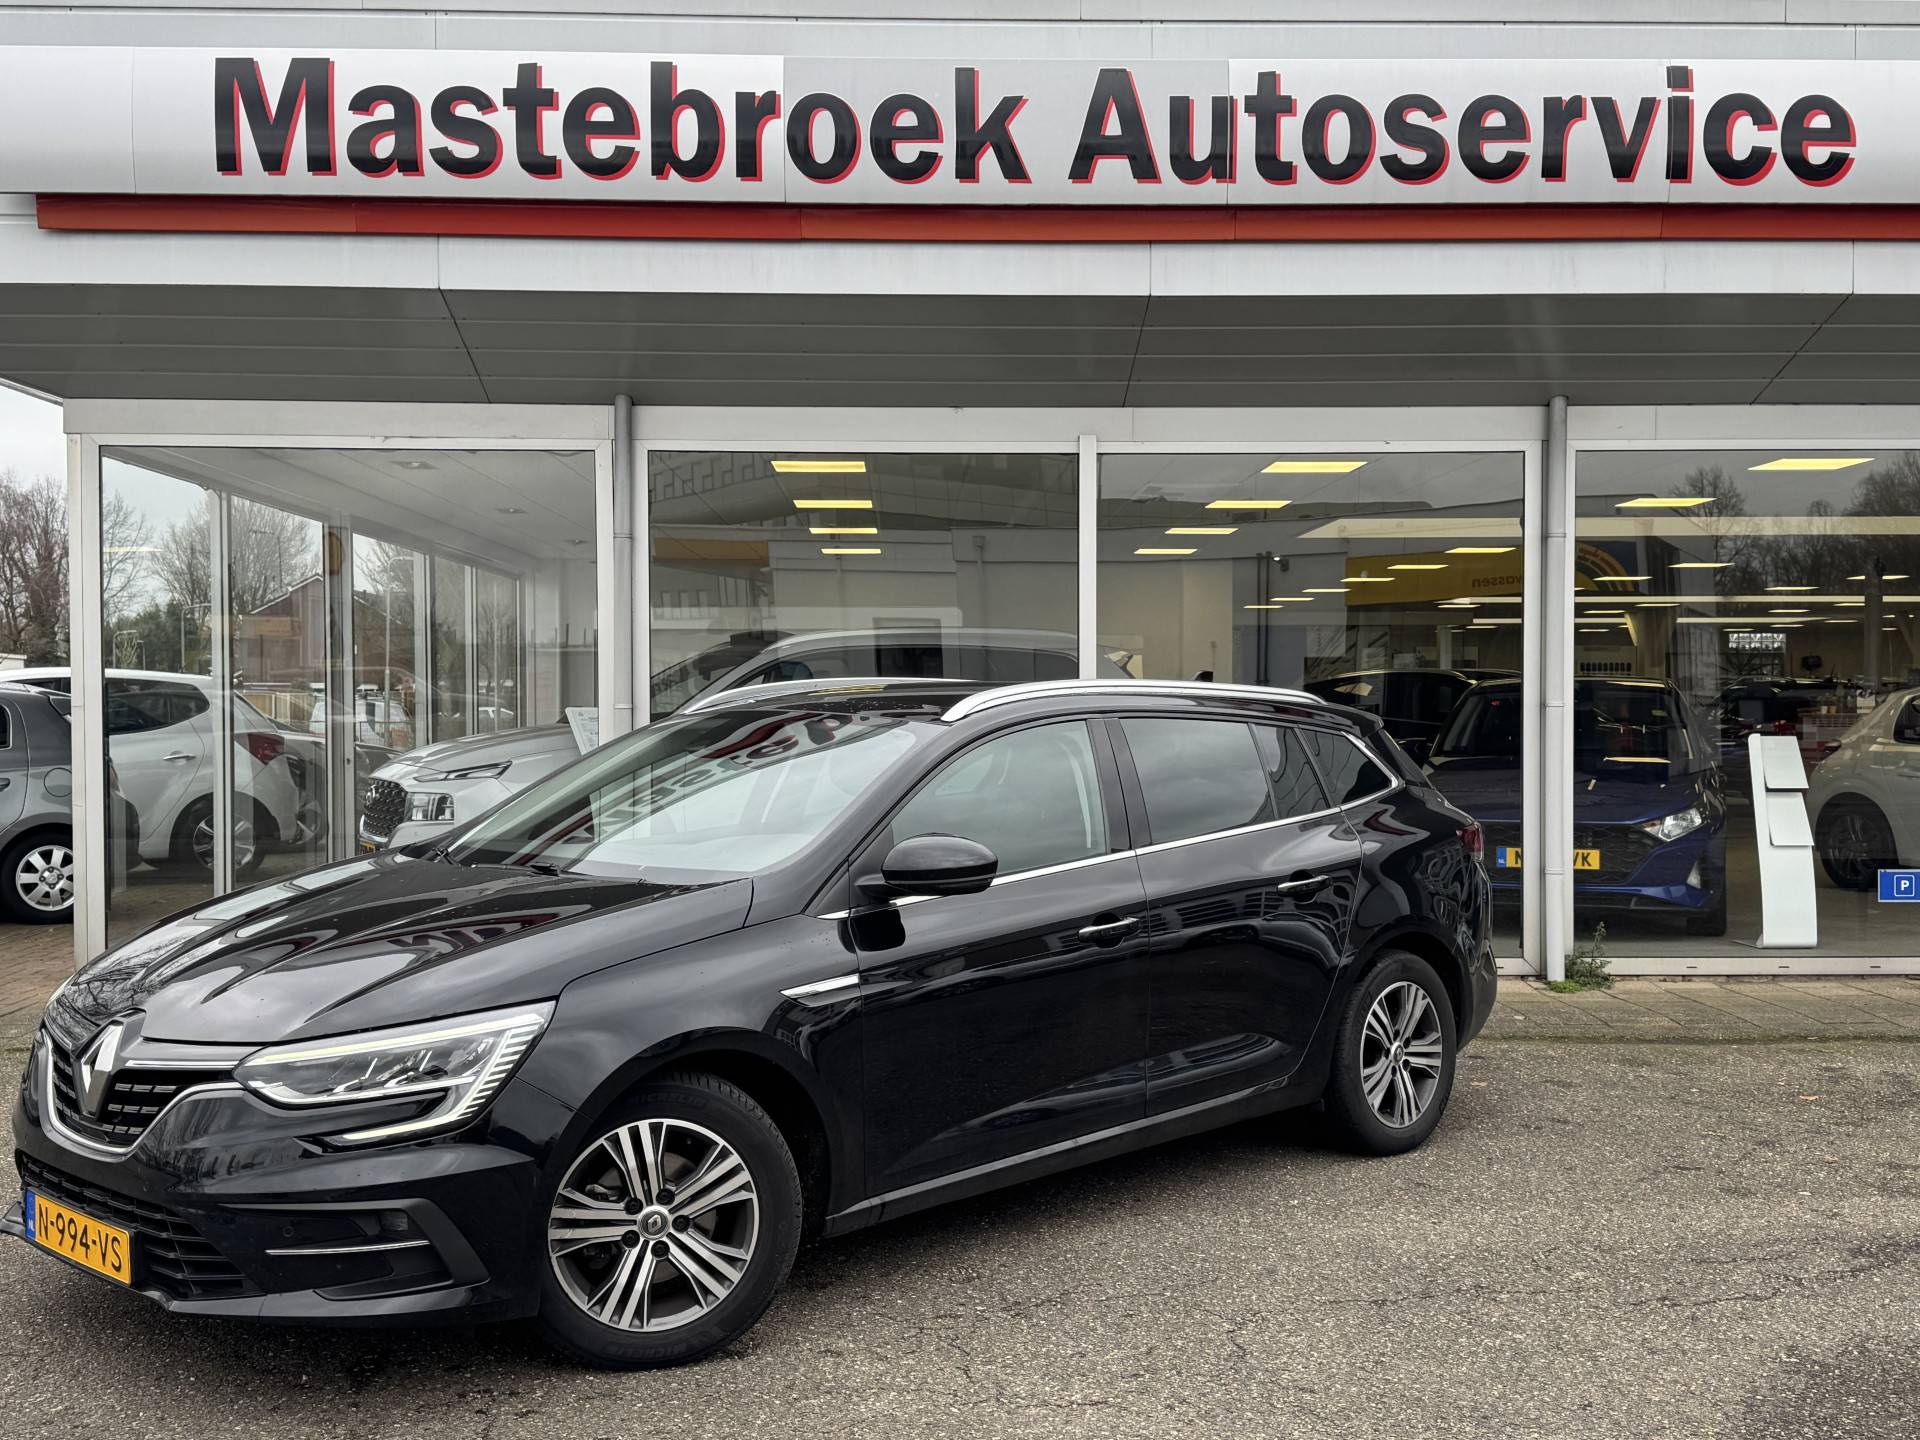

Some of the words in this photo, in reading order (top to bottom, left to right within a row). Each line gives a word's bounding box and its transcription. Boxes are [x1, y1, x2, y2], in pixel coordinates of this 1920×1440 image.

[214, 57, 1033, 184] Mastebroek
[1068, 66, 1857, 186] Autoservice
[28, 1218, 35, 1231] NL
[38, 1203, 122, 1273] N-994-VS
